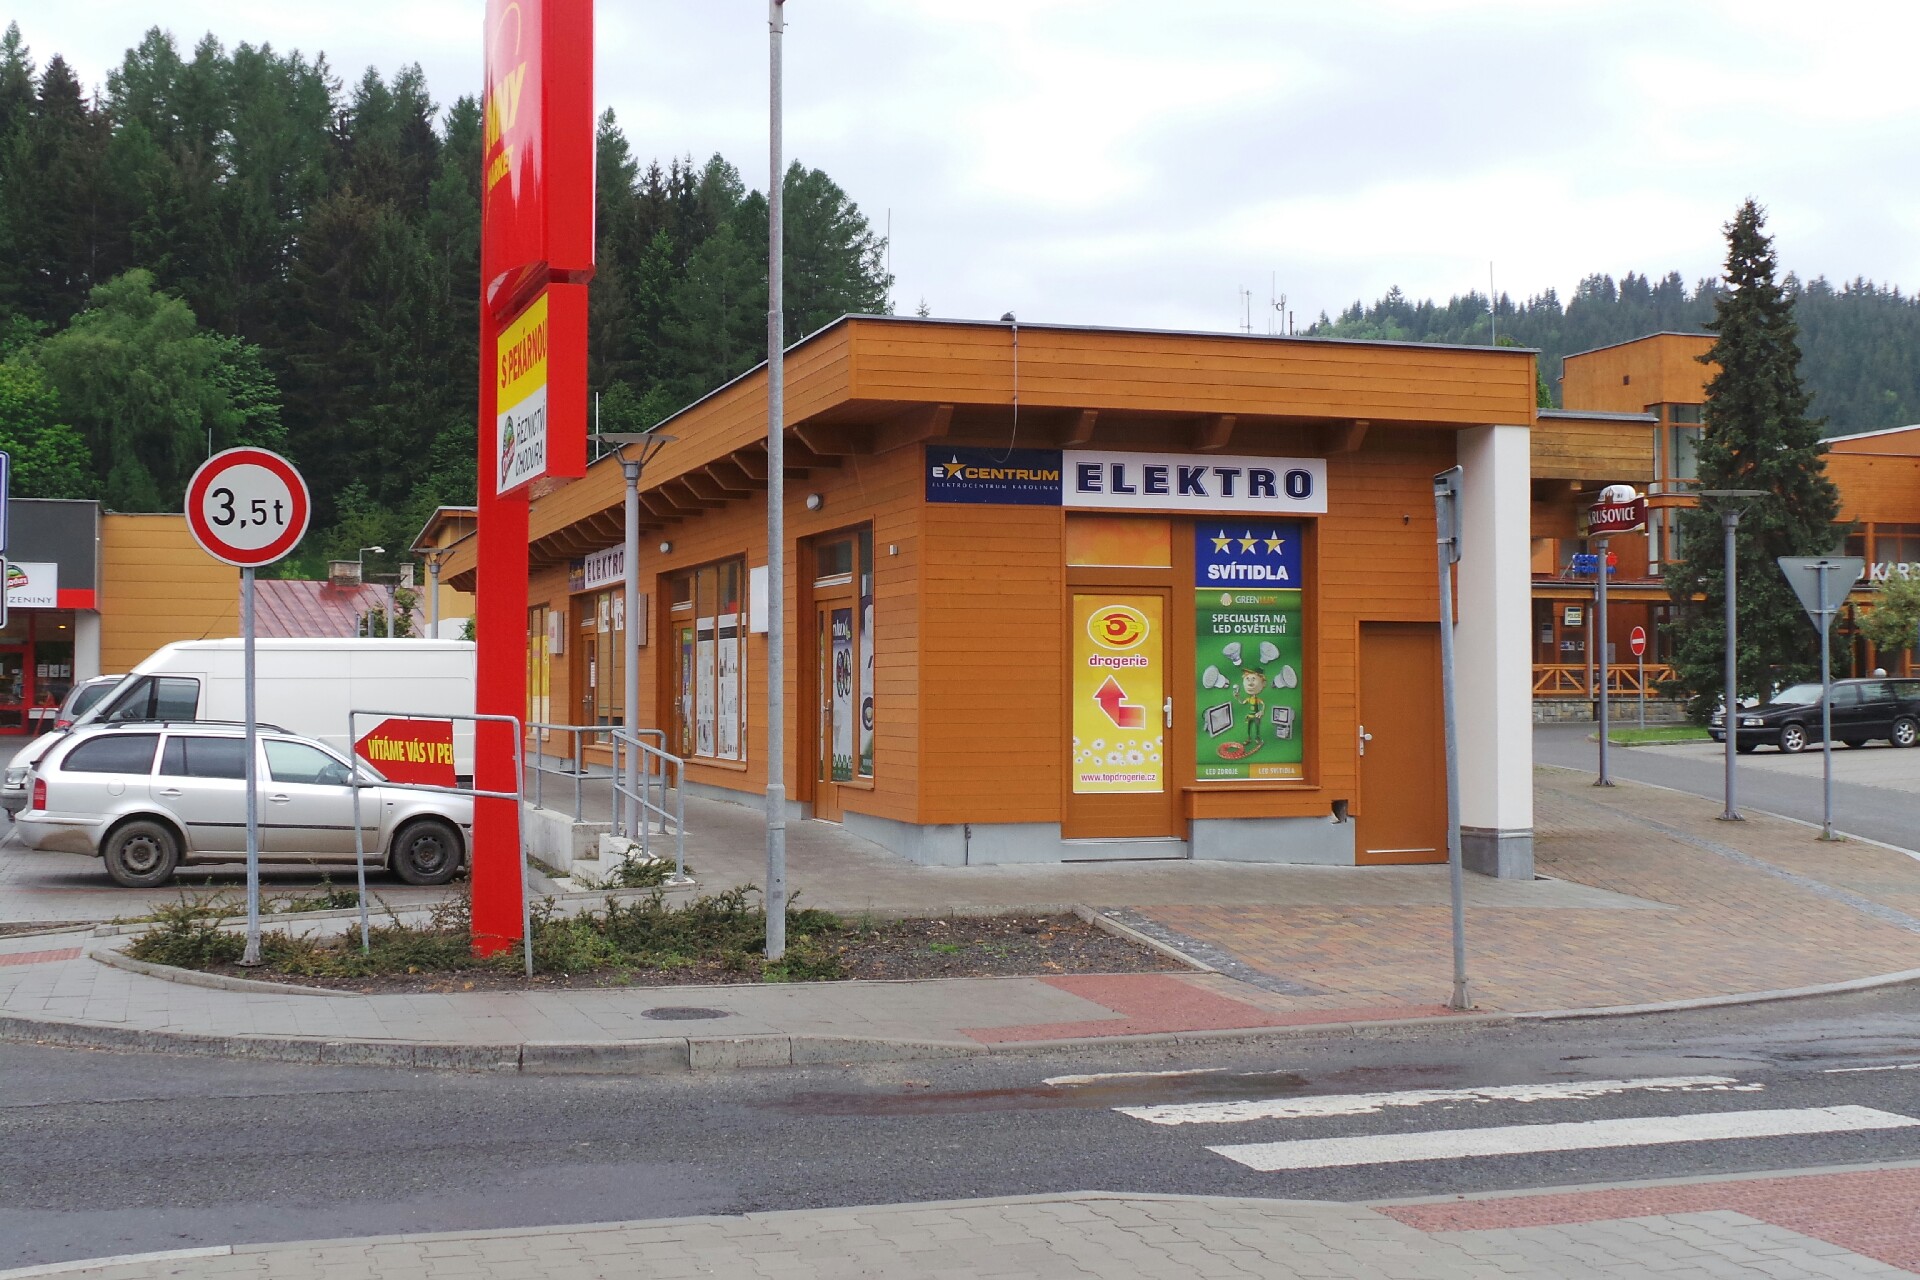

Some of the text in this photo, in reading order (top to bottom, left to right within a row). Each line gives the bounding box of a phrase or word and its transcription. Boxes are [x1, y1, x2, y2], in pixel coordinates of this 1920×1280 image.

[501, 317, 547, 389] S PEKÁRNOU
[515, 439, 543, 477] CHODURA
[965, 467, 1059, 481] CENTRUM
[1075, 461, 1314, 501] ELEKTRO
[587, 549, 625, 584] ELEKTRO
[1207, 561, 1289, 580] SVÍTIDLA
[7, 596, 53, 604] ZENINY
[1212, 614, 1287, 623] SPECIALISTA NA
[1213, 623, 1286, 634] LED OSVĚTLENÍ
[1089, 654, 1148, 669] drogerie
[368, 735, 405, 761] VÍTÁME
[405, 737, 426, 763] VÁS
[427, 742, 435, 764] V
[1081, 773, 1156, 783] www.topdrogerie.cz
